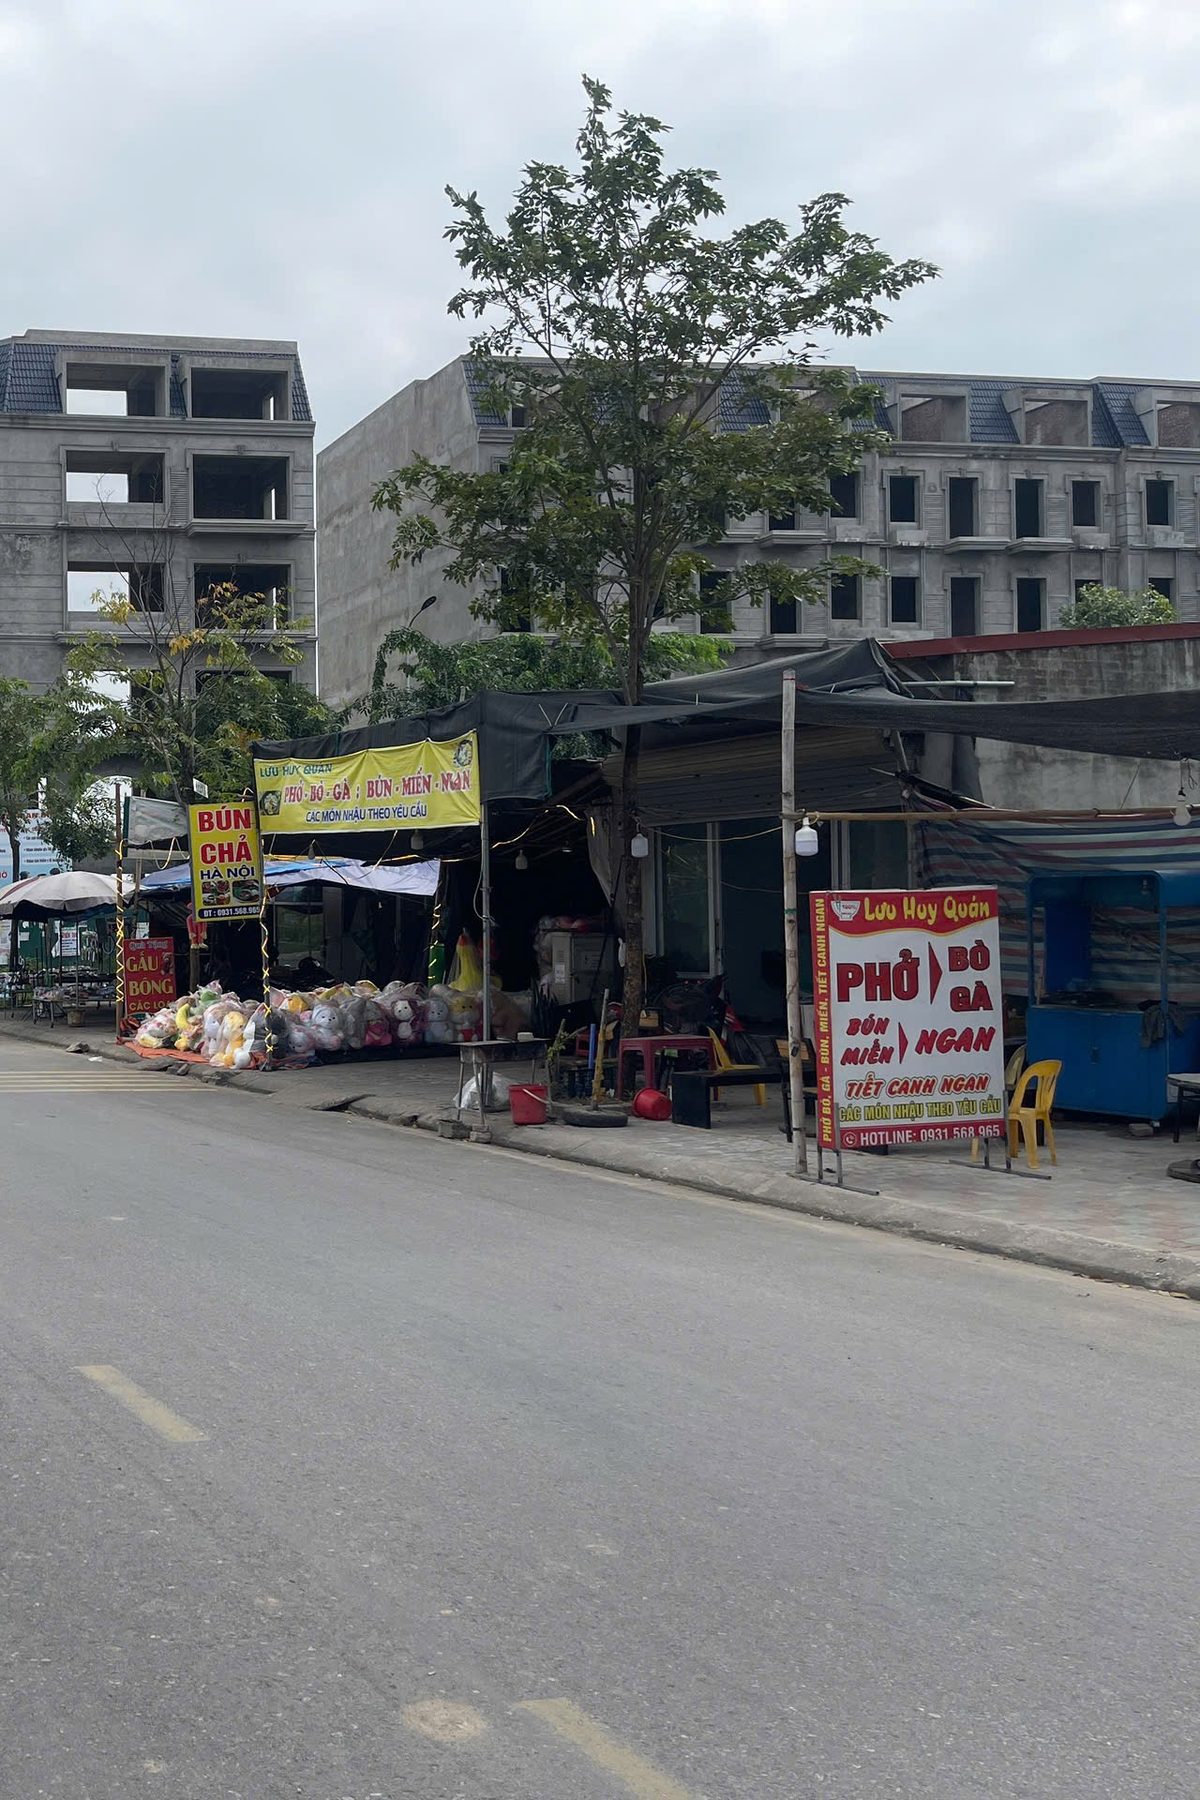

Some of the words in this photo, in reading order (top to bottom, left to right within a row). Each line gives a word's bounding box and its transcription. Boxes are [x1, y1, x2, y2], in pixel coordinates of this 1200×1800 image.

[333, 778, 351, 801] GÀ
[367, 774, 392, 798] BÚN
[198, 806, 252, 833] BÚN
[368, 807, 390, 820] THEO
[200, 834, 253, 864] CHẢ
[200, 867, 223, 880] HÀ
[226, 865, 255, 880] NỘI
[816, 898, 826, 931] NGAN
[864, 896, 897, 921] Lưu
[903, 896, 938, 926] Huy
[943, 895, 990, 922] Quán
[126, 951, 159, 972] GẤU
[817, 935, 827, 967] CANH
[948, 939, 991, 972] BÒ
[128, 977, 174, 997] BÔNG
[836, 948, 921, 1003] PHỞ
[950, 980, 994, 1013] GÀ
[846, 1013, 890, 1036] BÚN
[840, 1038, 895, 1066] MIẾN
[914, 1027, 996, 1056] NGAN
[846, 1072, 885, 1099] TIẾT
[887, 1077, 937, 1097] CANH
[939, 1074, 991, 1095] NGAN
[839, 1102, 861, 1121] CÁC
[864, 1102, 891, 1121] MÓN
[893, 1101, 924, 1121] NHẬU
[926, 1101, 954, 1118] THEO
[956, 1097, 977, 1116] YÊU
[860, 1129, 917, 1147] HOTLINE:
